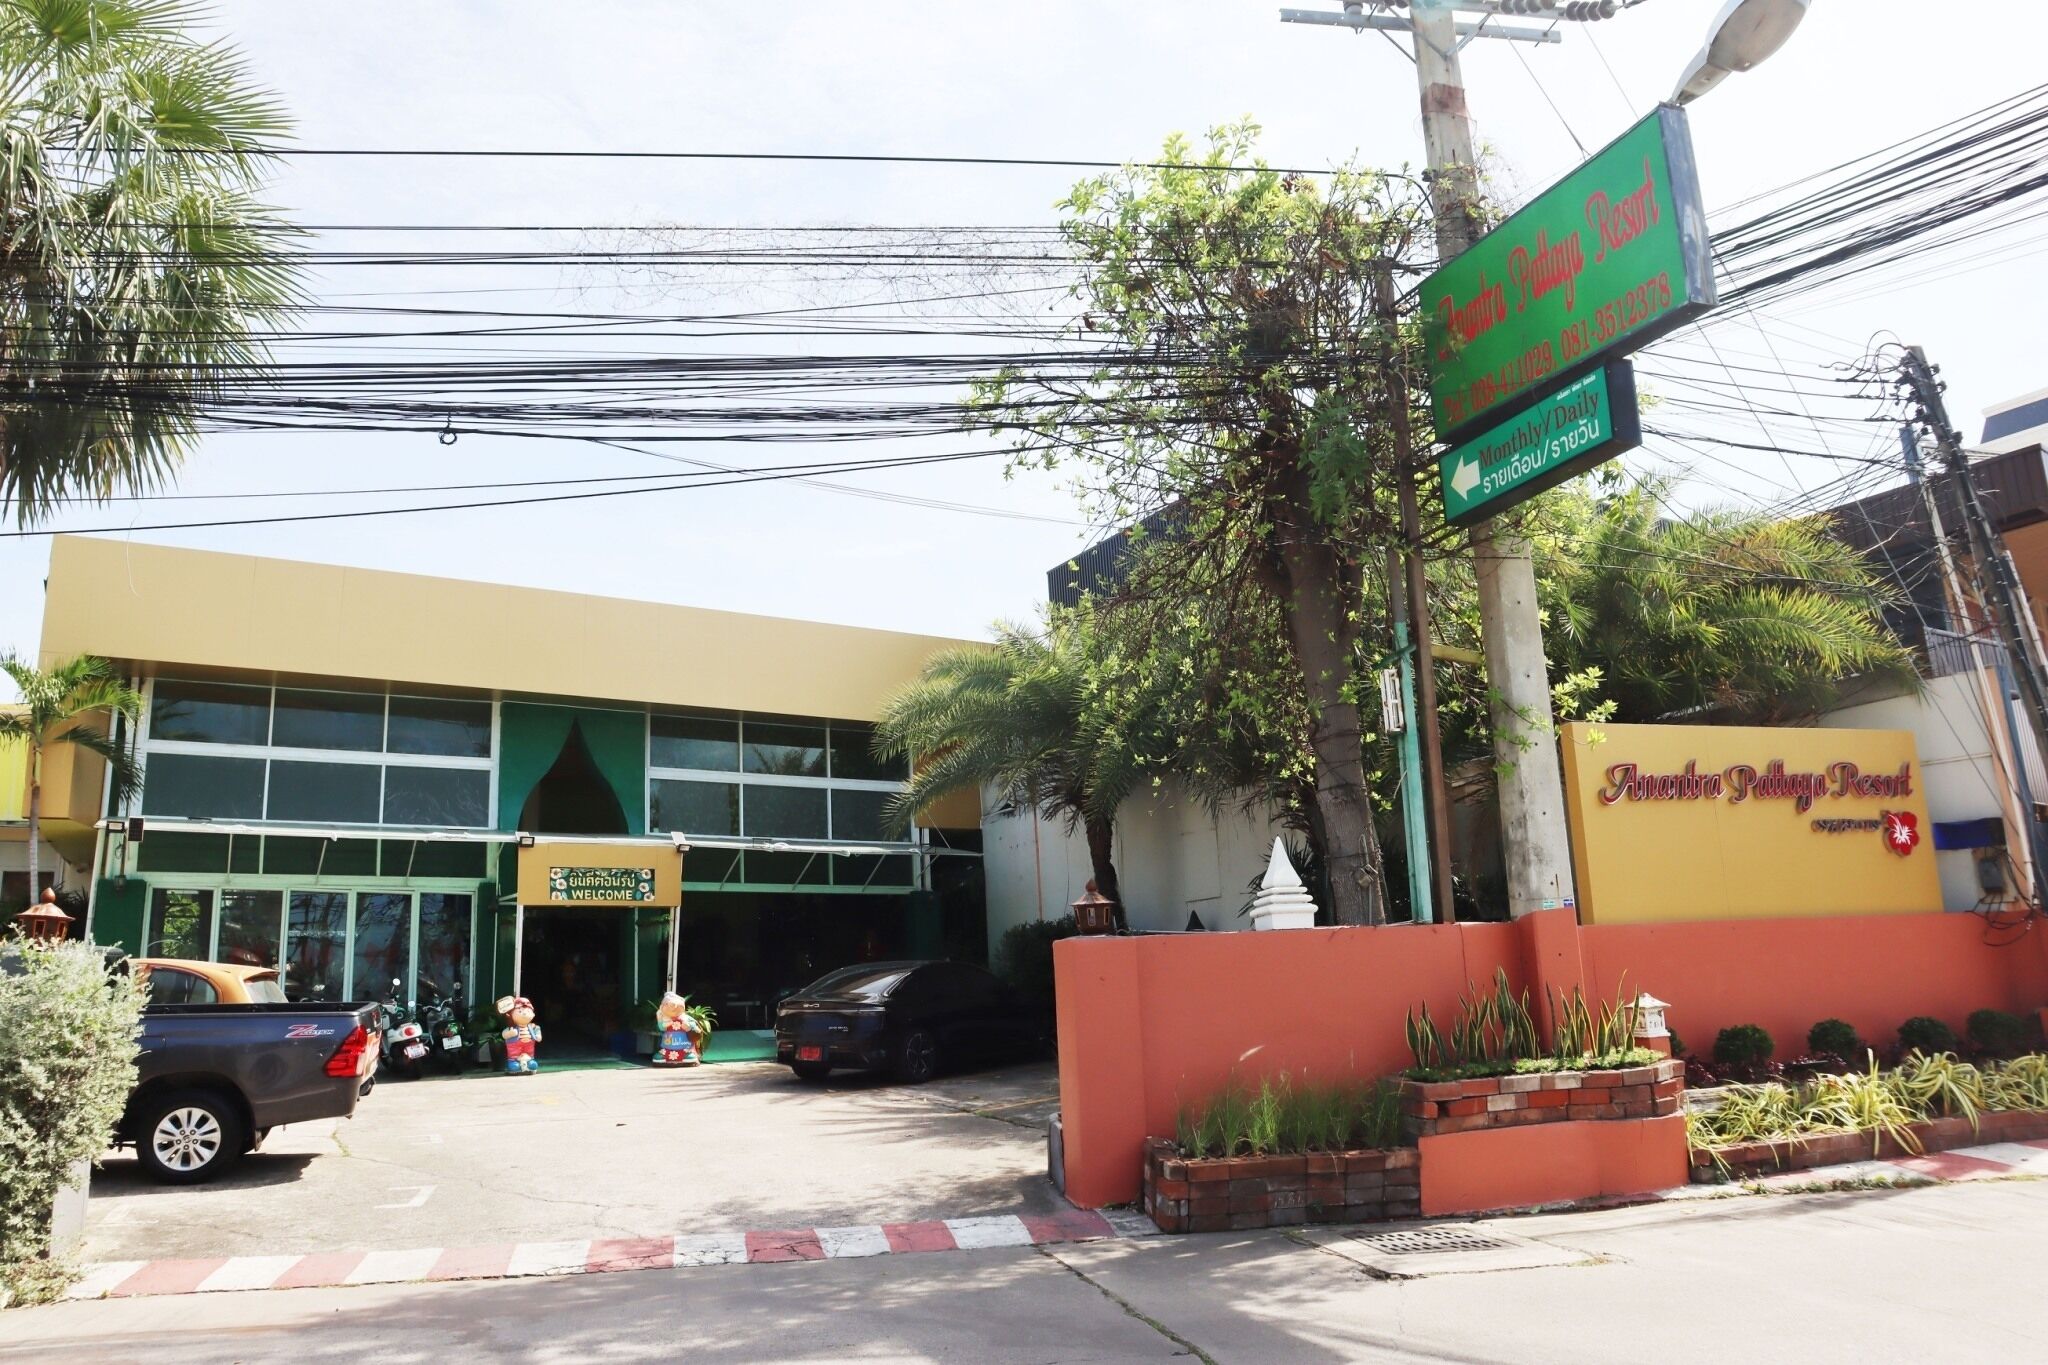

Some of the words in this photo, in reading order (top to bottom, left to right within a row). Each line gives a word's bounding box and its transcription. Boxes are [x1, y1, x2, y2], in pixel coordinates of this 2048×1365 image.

[1508, 227, 1584, 313] Pattaya
[1585, 154, 1659, 263] Resort
[1600, 759, 1726, 806] Anantra
[1723, 758, 1829, 814] Pattaya
[1830, 760, 1914, 799] Resort
[571, 889, 633, 901] WELCOME
